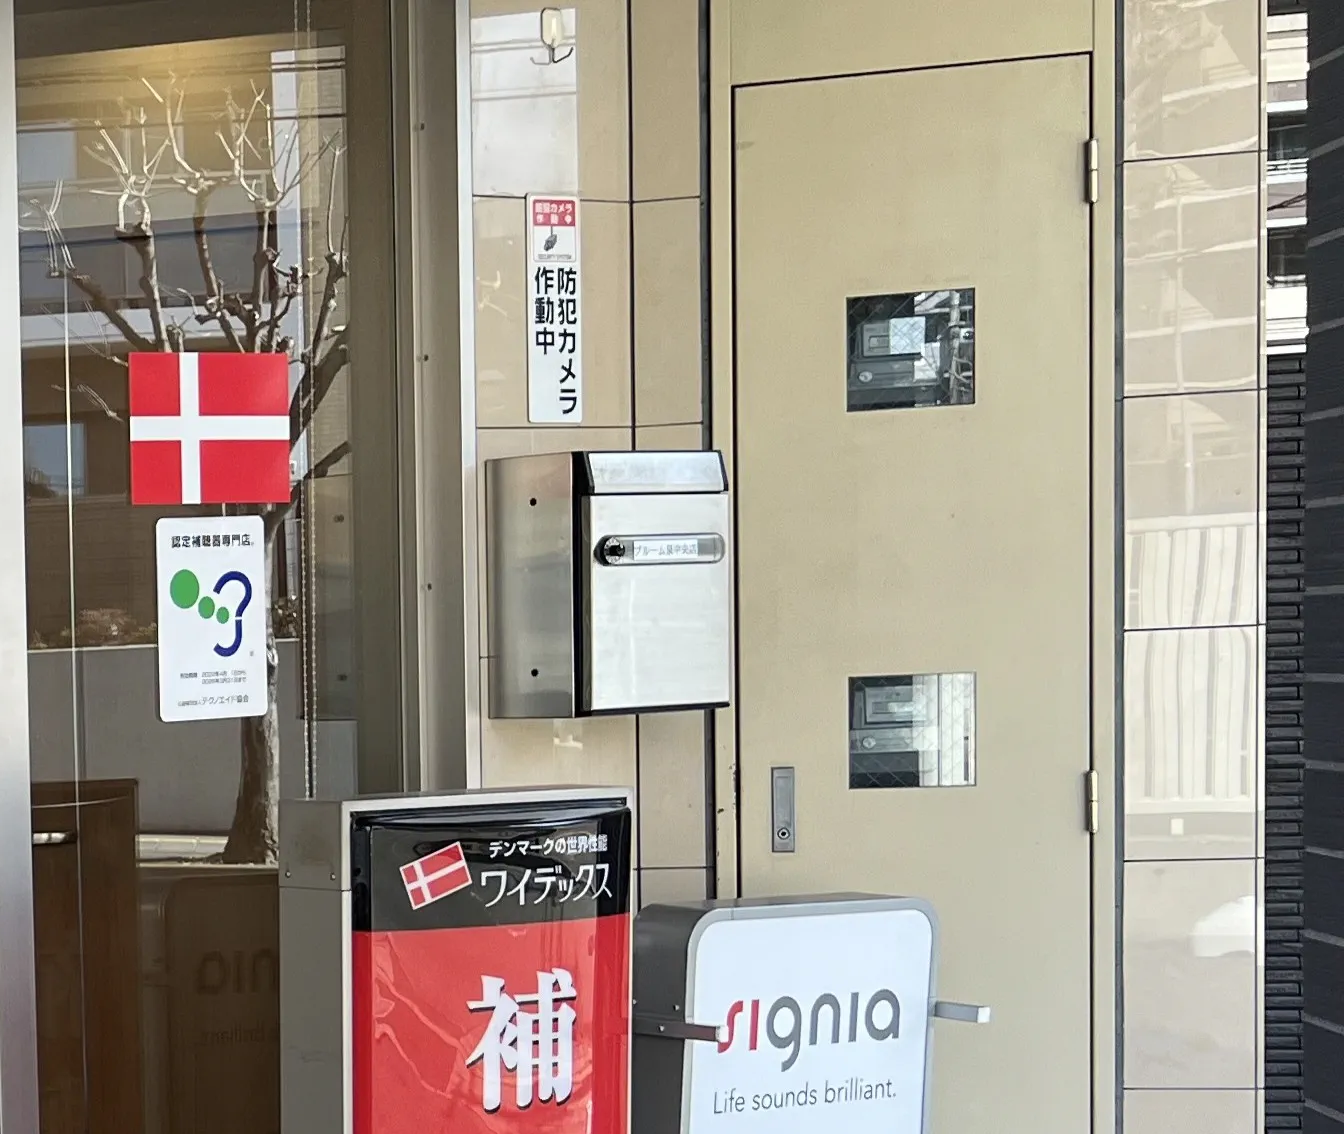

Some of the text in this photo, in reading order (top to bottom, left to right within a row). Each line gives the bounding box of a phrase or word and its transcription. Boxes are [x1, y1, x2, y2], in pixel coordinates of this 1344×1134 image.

[534, 266, 555, 355] 作動中
[557, 267, 577, 415] 防犯カメラ
[171, 534, 251, 548] 認定補聴器専門店
[489, 834, 608, 859] デンマークの世界性能
[481, 863, 613, 908] ワイデックス
[717, 988, 901, 1072] signia
[713, 1077, 897, 1114] Life sounds brilliant.
